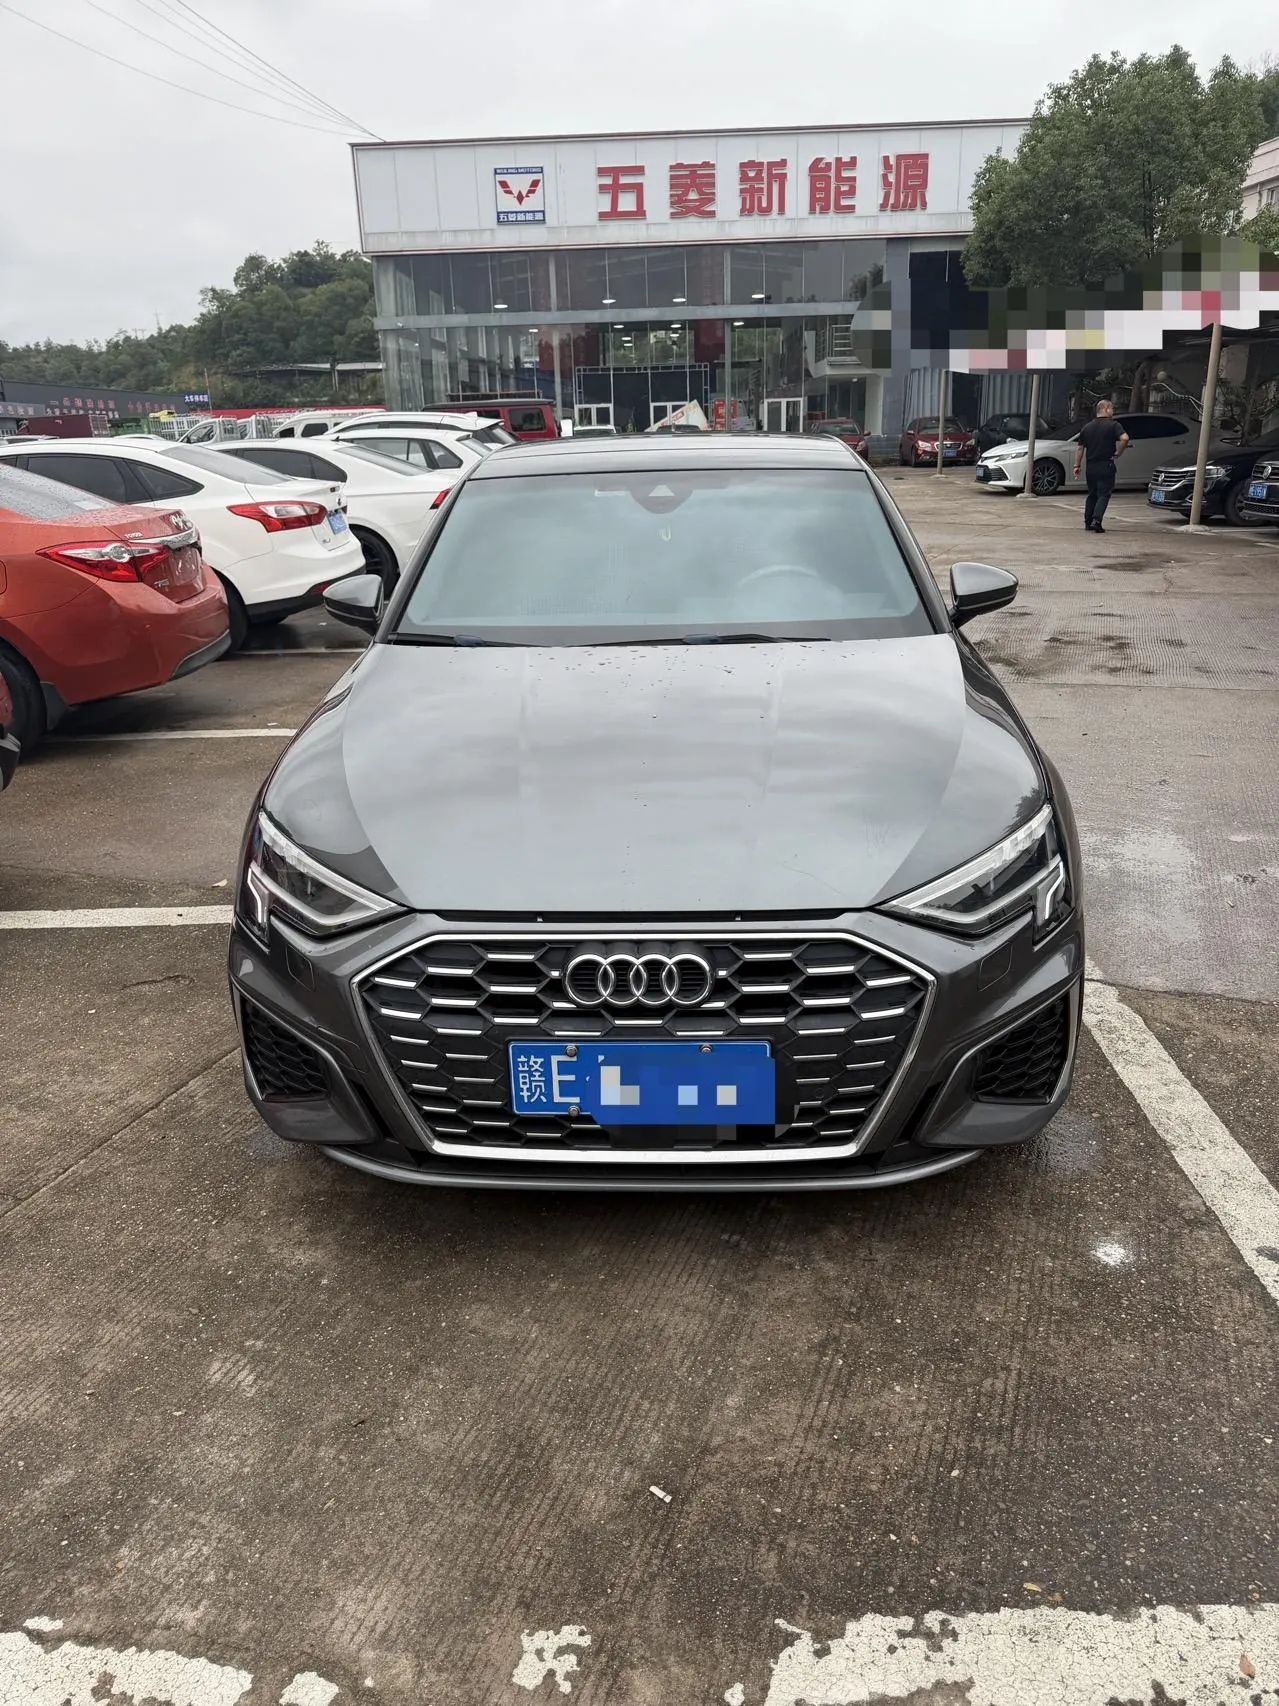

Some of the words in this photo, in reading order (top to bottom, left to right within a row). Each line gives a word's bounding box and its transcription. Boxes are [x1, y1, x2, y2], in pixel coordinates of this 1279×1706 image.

[596, 152, 931, 221] 五菱新能源
